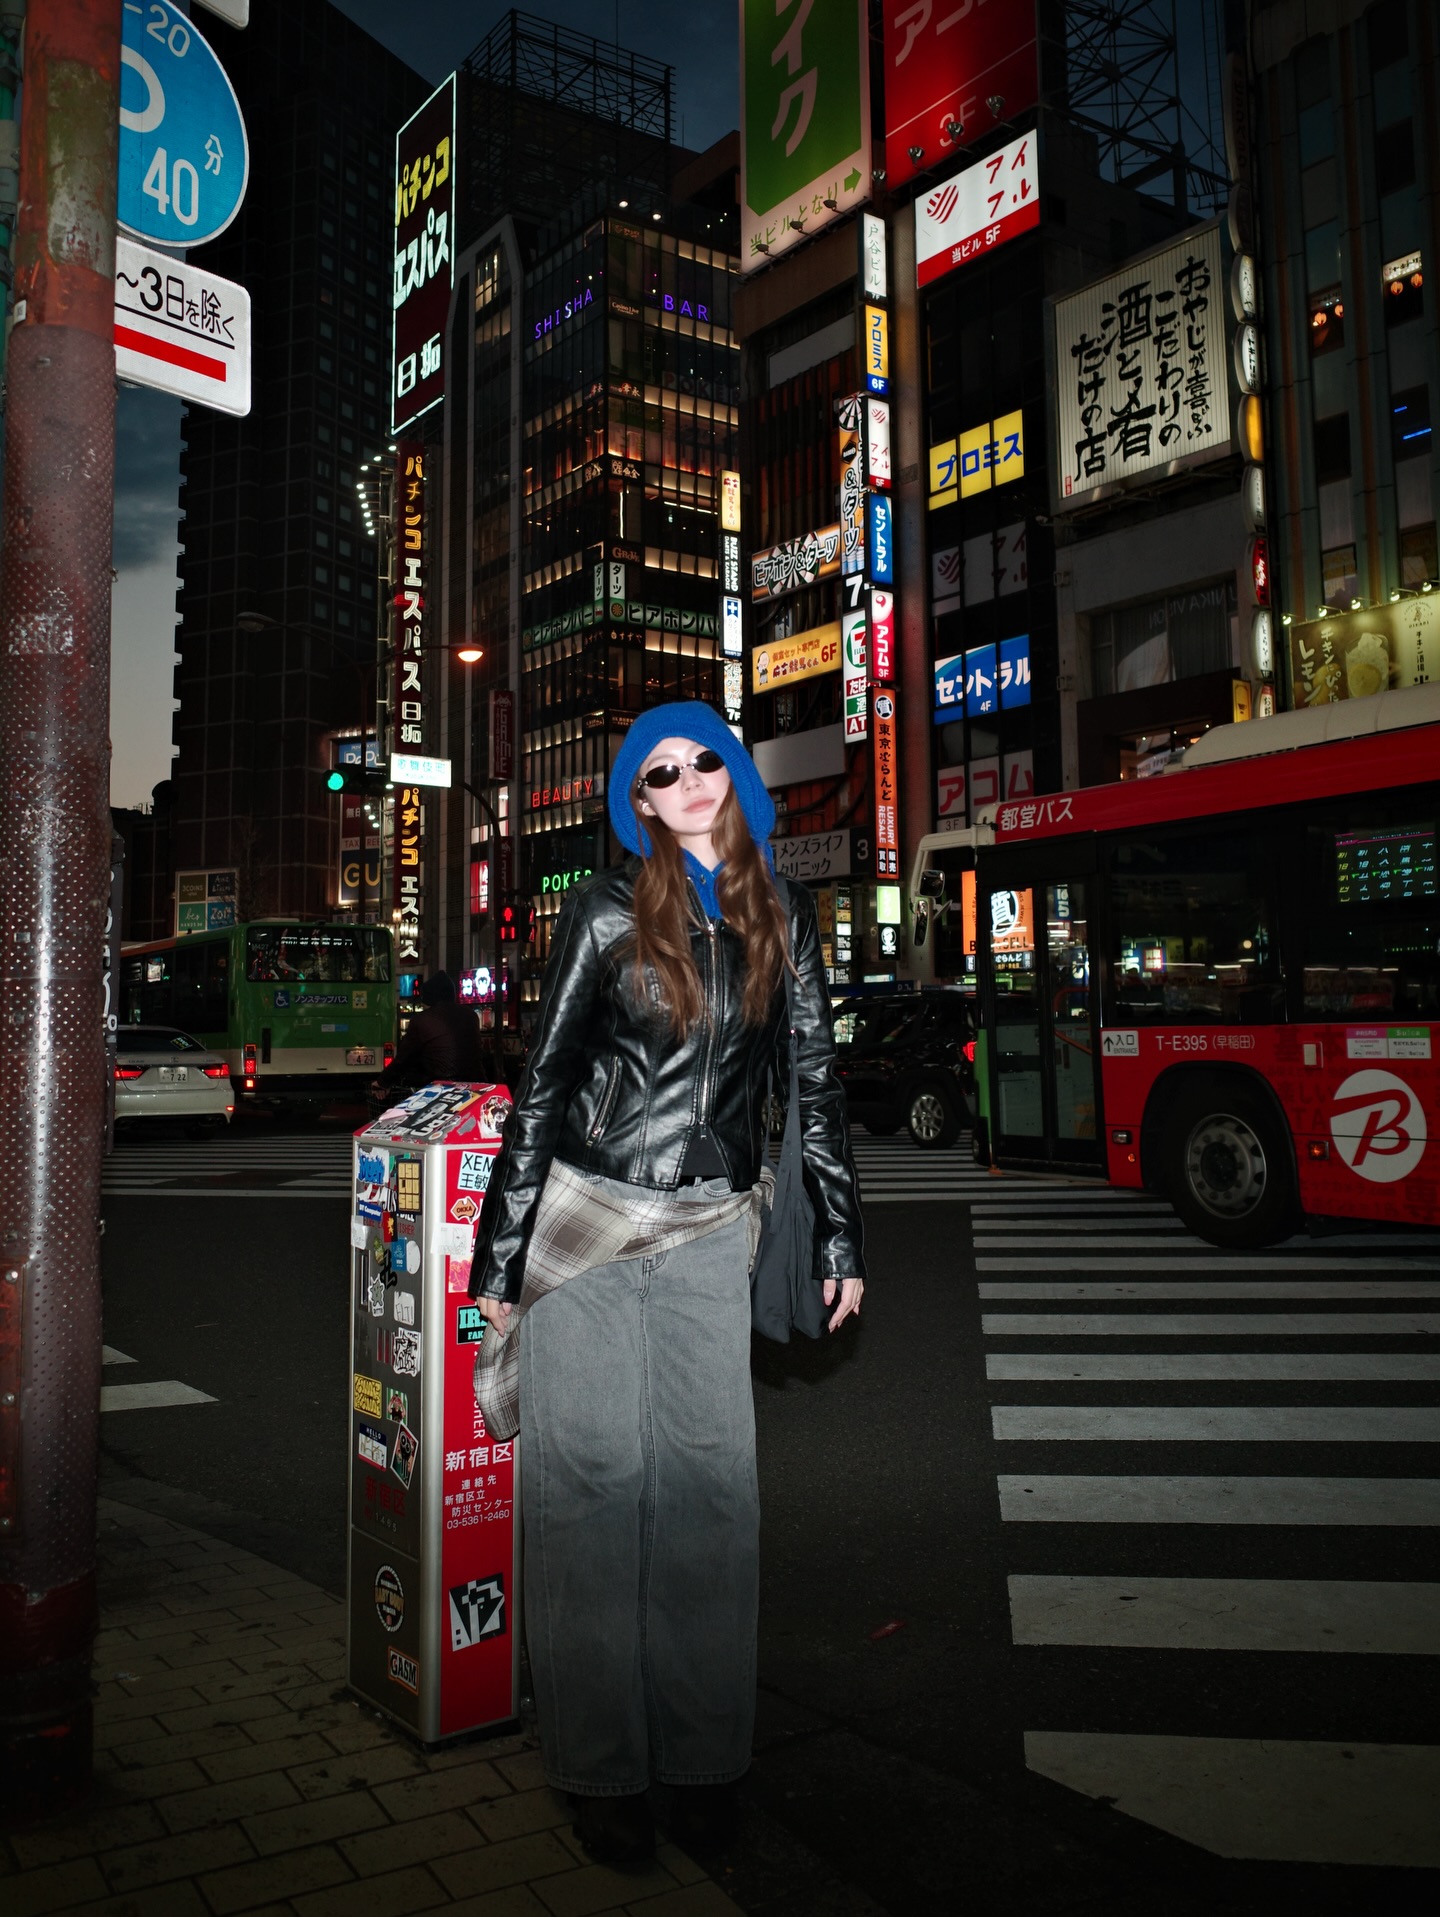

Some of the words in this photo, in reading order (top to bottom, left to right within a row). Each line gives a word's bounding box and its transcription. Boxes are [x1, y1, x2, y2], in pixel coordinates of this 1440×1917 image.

[204, 134, 224, 176] 分
[143, 147, 198, 226] 40
[396, 137, 449, 226] パチンコ
[394, 207, 448, 309] エスパス
[868, 224, 881, 287] 戸谷ビル
[951, 238, 982, 264] 当ビル
[986, 225, 1001, 245] 5F
[535, 289, 593, 338] SHISHA
[665, 294, 710, 322] BAR
[871, 315, 882, 371] プロミス
[1175, 256, 1212, 440] おやじが喜ぶ
[871, 378, 885, 391] 6F
[1153, 290, 1184, 446] こだわりの
[1071, 333, 1108, 482] だけの店
[937, 433, 1023, 487] プロミス
[405, 455, 423, 550] パチンコ
[875, 505, 888, 573] セントラル
[612, 564, 622, 594] ダーツ
[403, 558, 422, 692] エスパス
[628, 603, 720, 635] ビアポンバ
[821, 643, 837, 662] 6F
[877, 625, 889, 666] アコム
[878, 668, 889, 678] 3F
[936, 657, 1031, 704] セントラル
[1299, 640, 1321, 702] レモン
[727, 708, 741, 720] 7F
[980, 700, 991, 712] 4F
[850, 717, 867, 734] AT
[879, 724, 891, 801] 東京ぶらんど
[532, 779, 593, 808] BEAUTY
[939, 764, 1034, 813] アコム
[402, 788, 419, 865] パチンコ
[946, 819, 960, 831] 3F
[1001, 797, 1074, 832] 都営バス
[780, 835, 843, 859] メンズライフ
[343, 862, 381, 888] GU
[781, 857, 831, 878] クリニック
[1116, 1034, 1135, 1046] 入口
[1156, 1035, 1207, 1051] T-E395
[366, 1427, 382, 1440] HELLO
[445, 1442, 512, 1472] 新宿区
[445, 1489, 485, 1506] 新宿区立
[461, 1475, 497, 1490] 連絡先
[447, 1509, 510, 1529] 03-5361-2460
[451, 1499, 512, 1518] 防災センター
